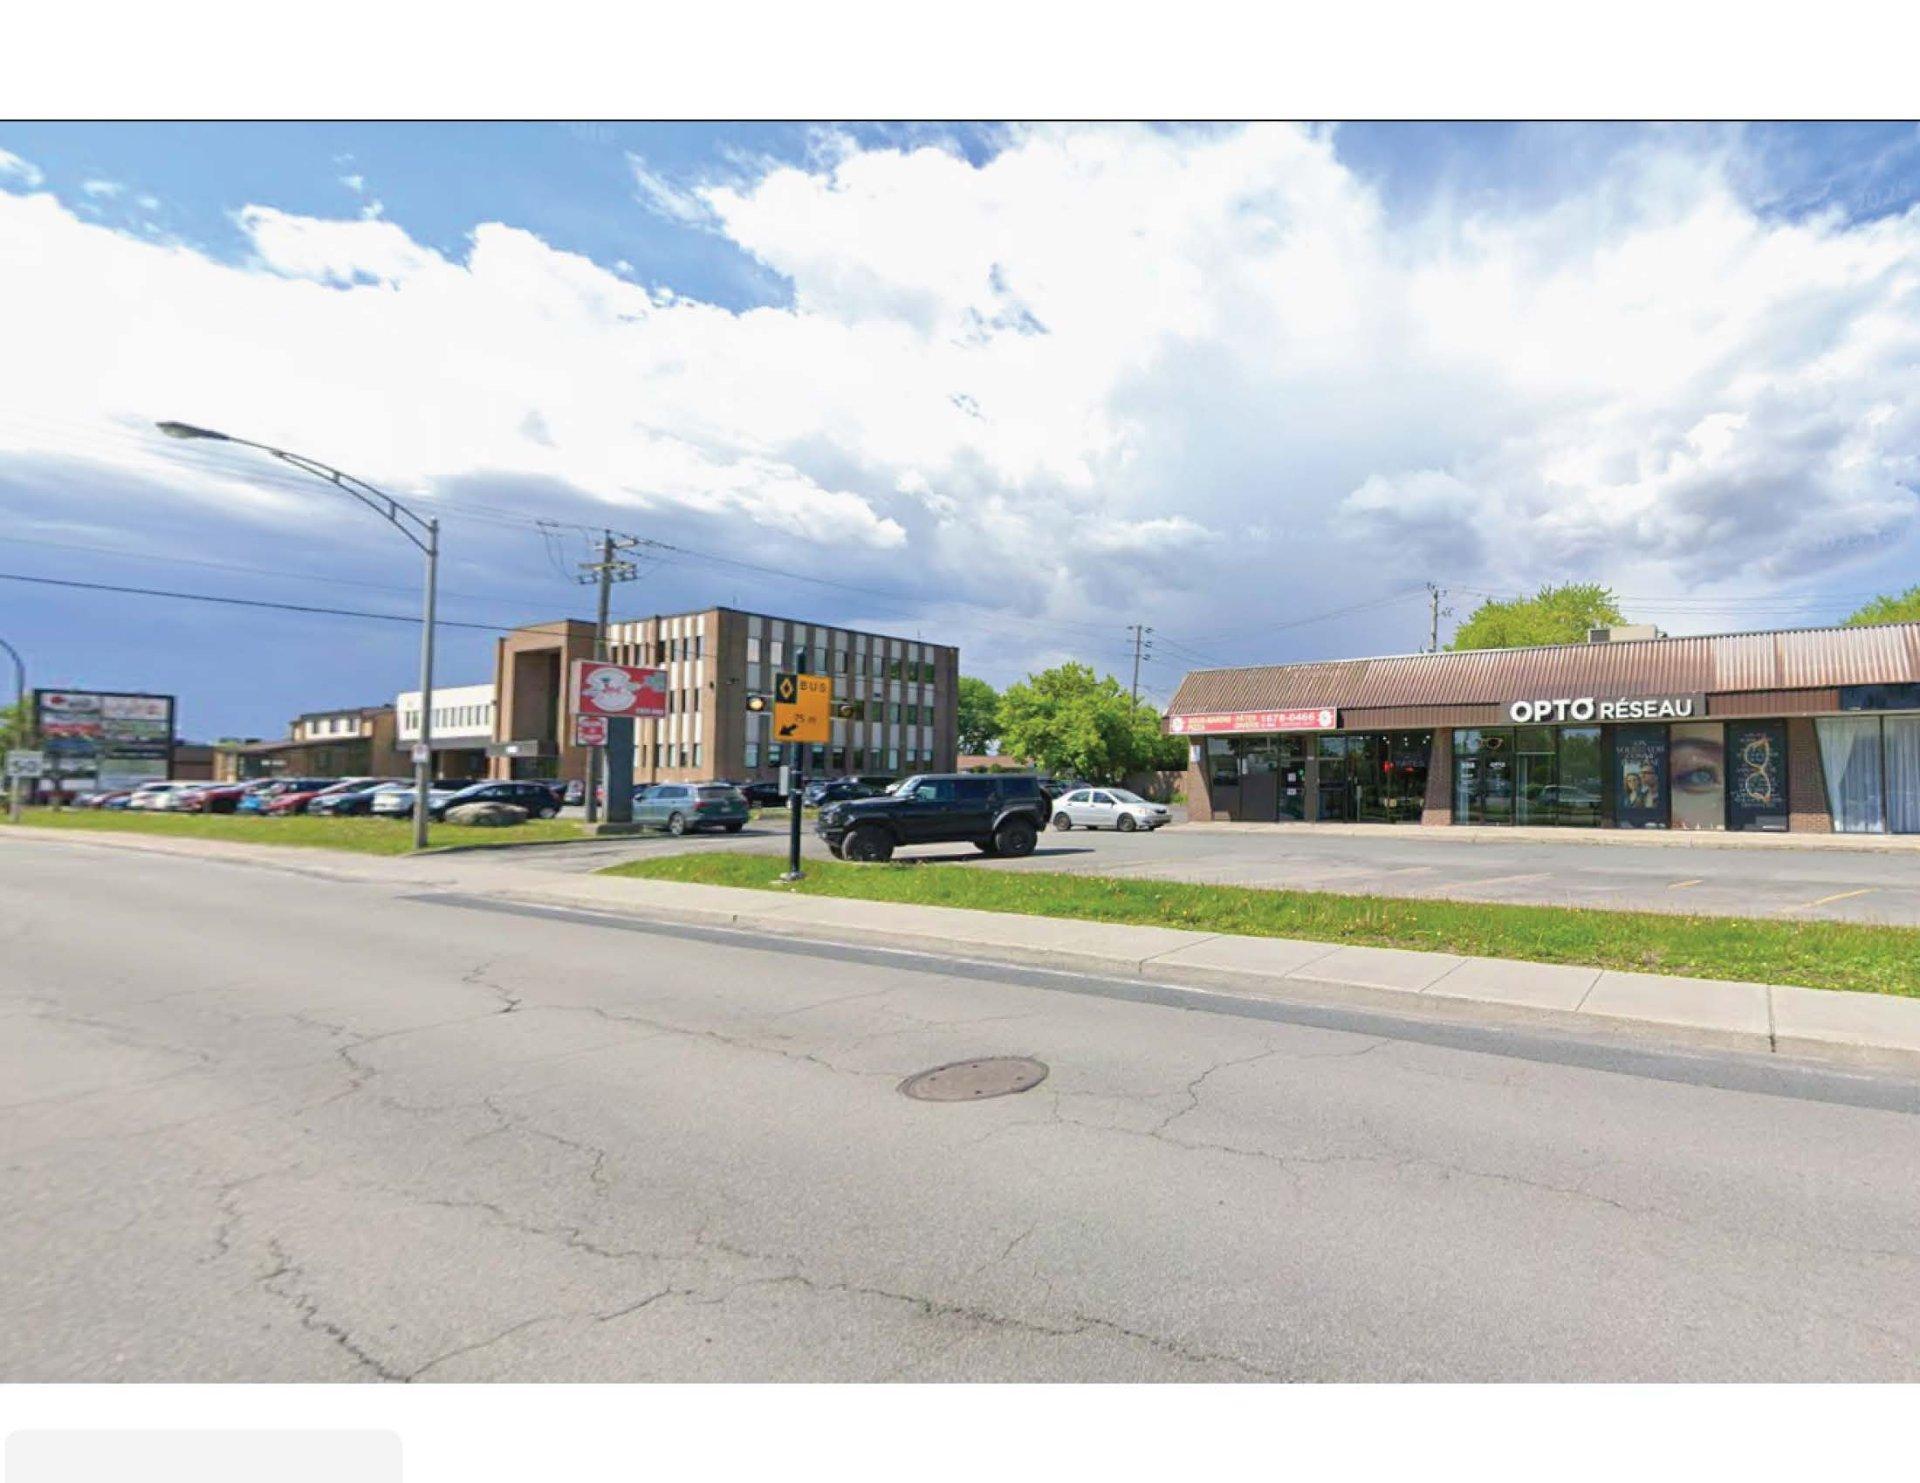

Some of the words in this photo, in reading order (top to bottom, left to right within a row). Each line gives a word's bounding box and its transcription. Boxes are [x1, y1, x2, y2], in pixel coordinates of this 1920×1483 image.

[800, 681, 826, 692] BUS
[1510, 697, 1595, 722] OPTO
[1600, 697, 1693, 719] RÉSEAU
